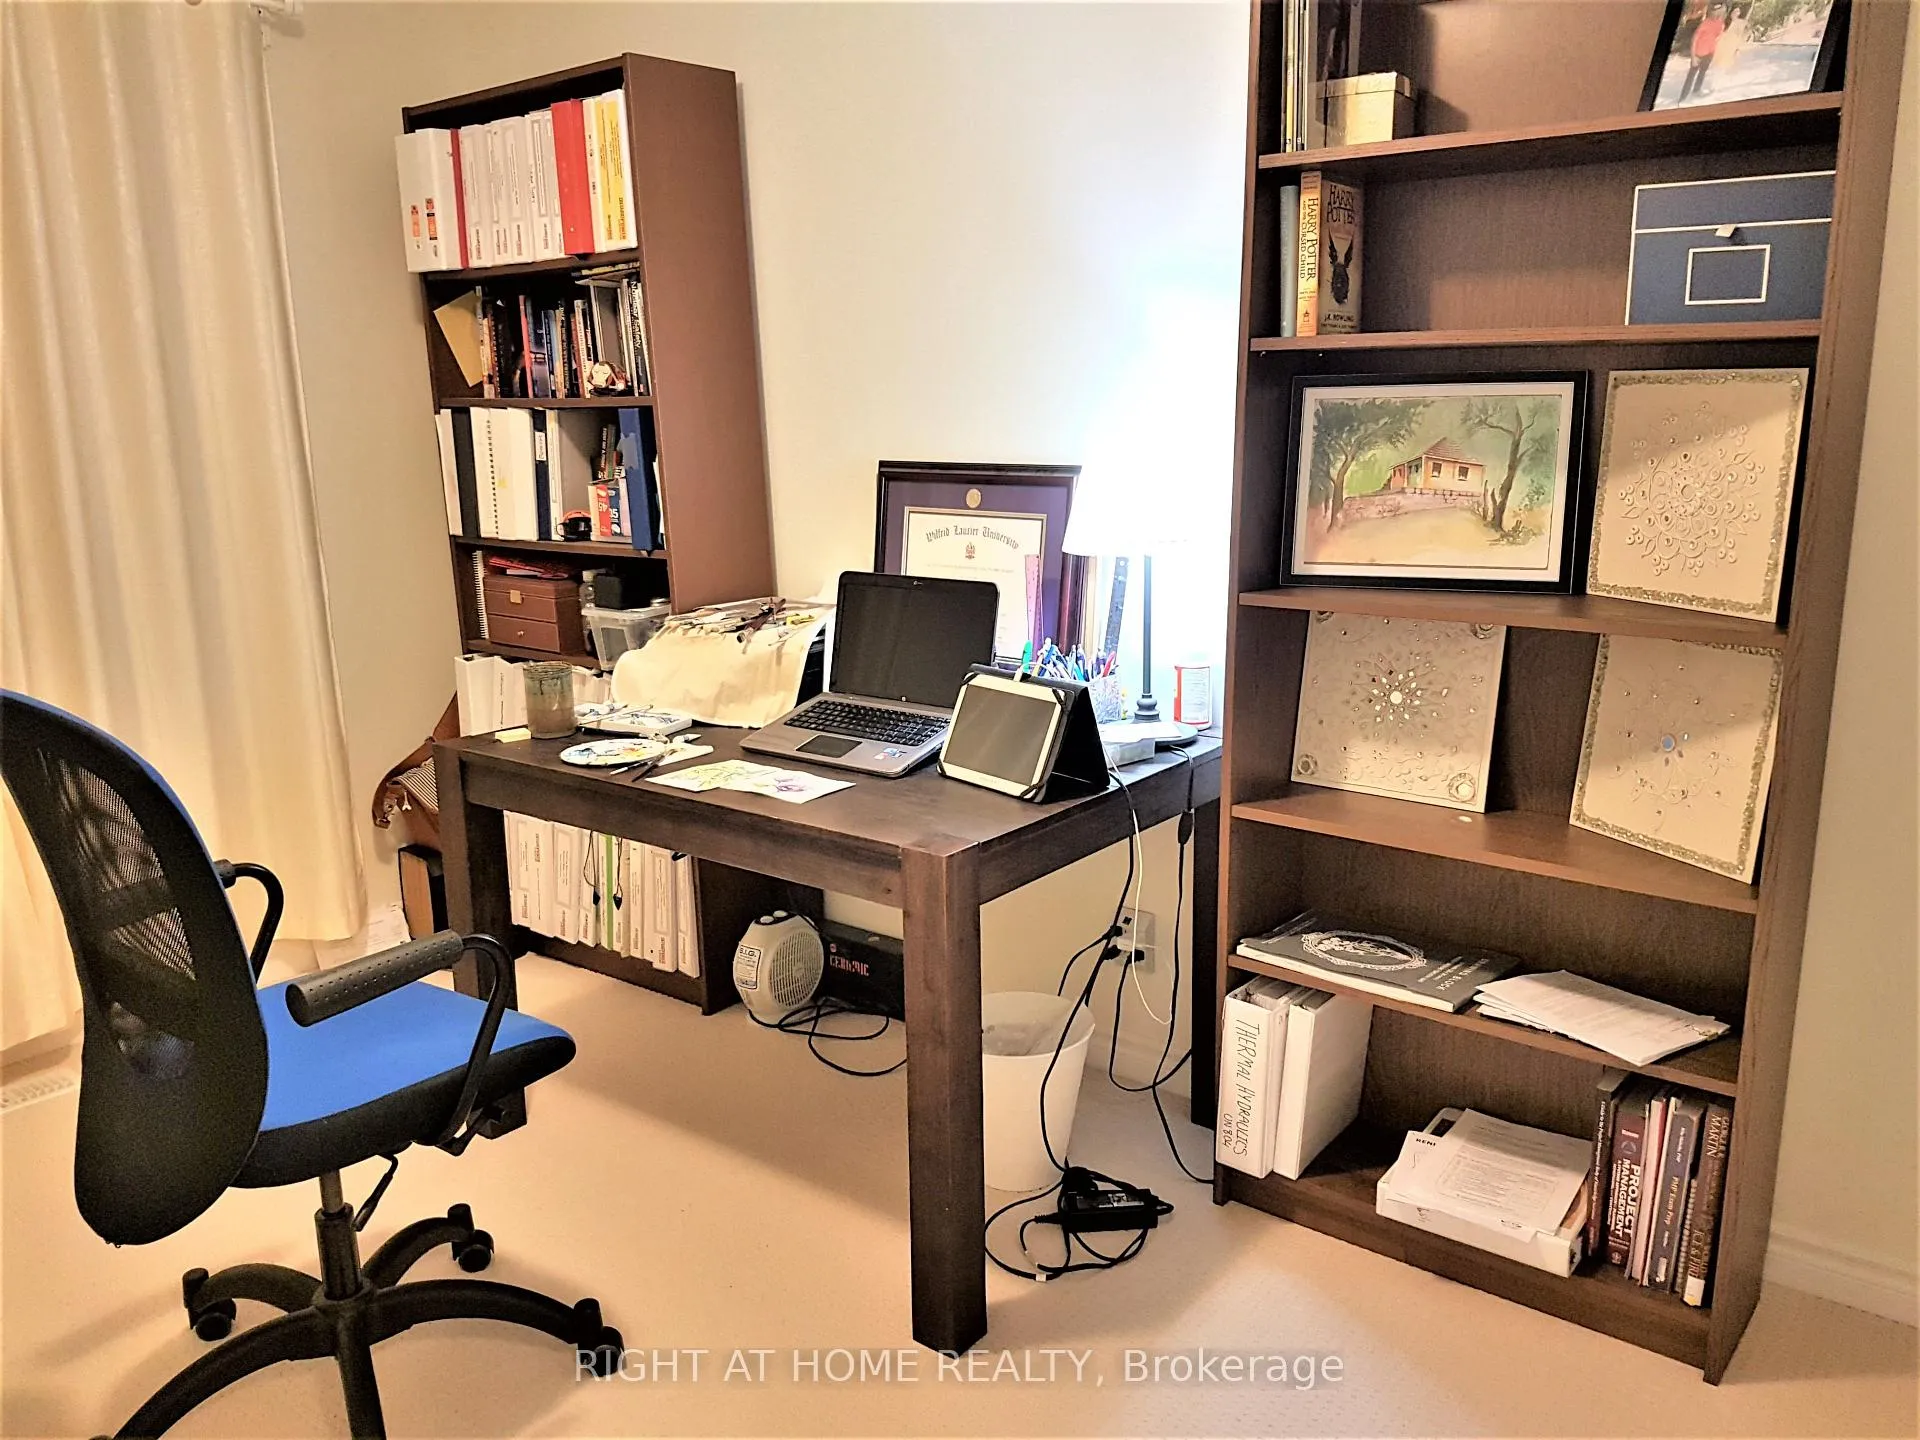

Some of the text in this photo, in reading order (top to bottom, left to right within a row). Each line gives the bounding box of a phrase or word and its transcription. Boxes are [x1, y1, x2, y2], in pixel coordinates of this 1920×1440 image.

[1330, 184, 1354, 208] HARRY
[1306, 197, 1318, 237] HARRY
[1306, 238, 1318, 282] POTTER
[926, 525, 1019, 550] Wilfrid Laurier University
[1233, 1019, 1260, 1157] THERMAL HYDRAULICS
[1706, 1114, 1718, 1157] MARTIN
[1616, 1158, 1632, 1236] MANAGEMENT
[1623, 1164, 1641, 1236] PROJECT
[1667, 1193, 1675, 1210] Exam
[1670, 1175, 1678, 1191] PMP
[1663, 1210, 1673, 1225] Prep
